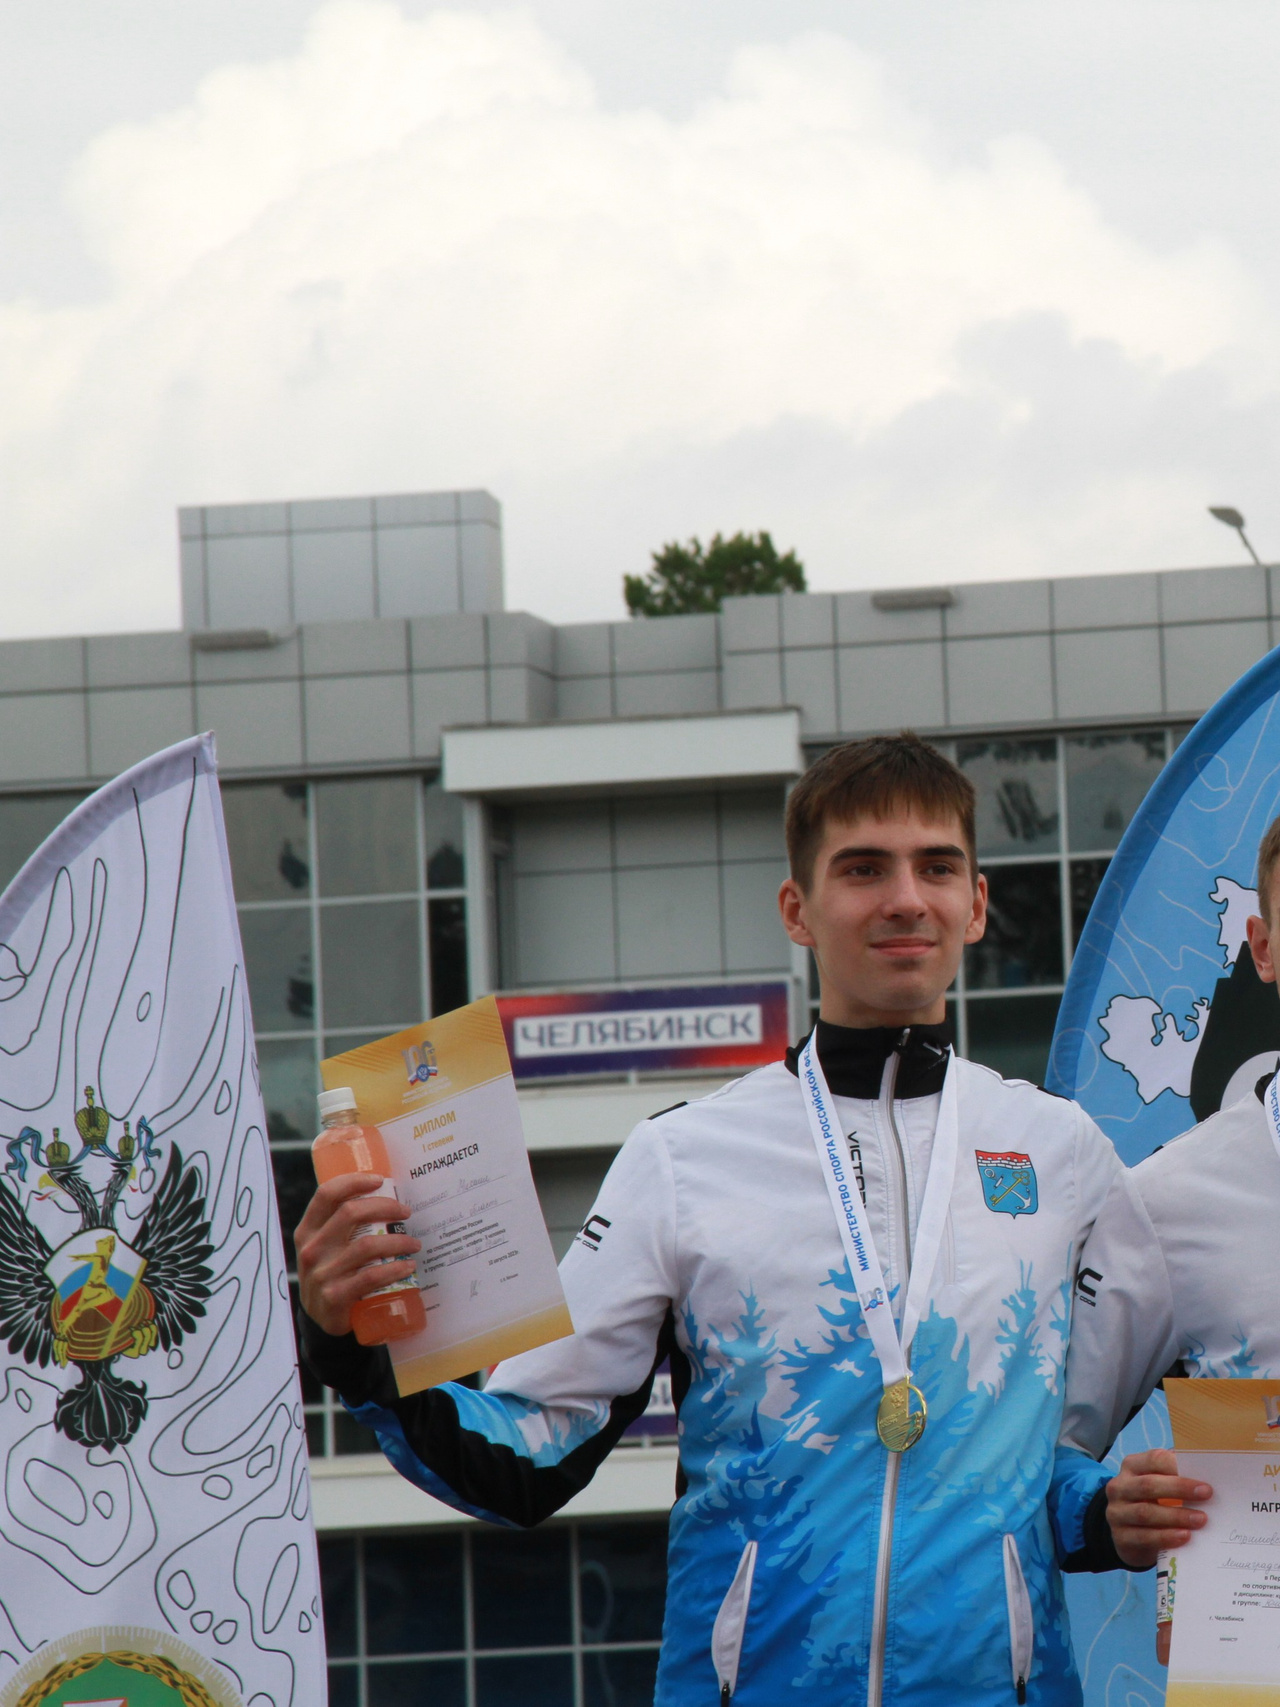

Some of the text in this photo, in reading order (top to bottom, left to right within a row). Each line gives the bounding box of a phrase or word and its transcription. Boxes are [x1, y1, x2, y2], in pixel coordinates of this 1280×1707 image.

[521, 1012, 755, 1048] ЧЕЛЯБИНСК
[413, 1111, 456, 1140] ДИПЛОМ
[410, 1143, 479, 1179] НАГРАЖДАЕТСЯ
[806, 1067, 869, 1271] МИНИСТЕРСТВО СПОРТА РОССИЙСКОЙ
[847, 1130, 867, 1208] VICTO
